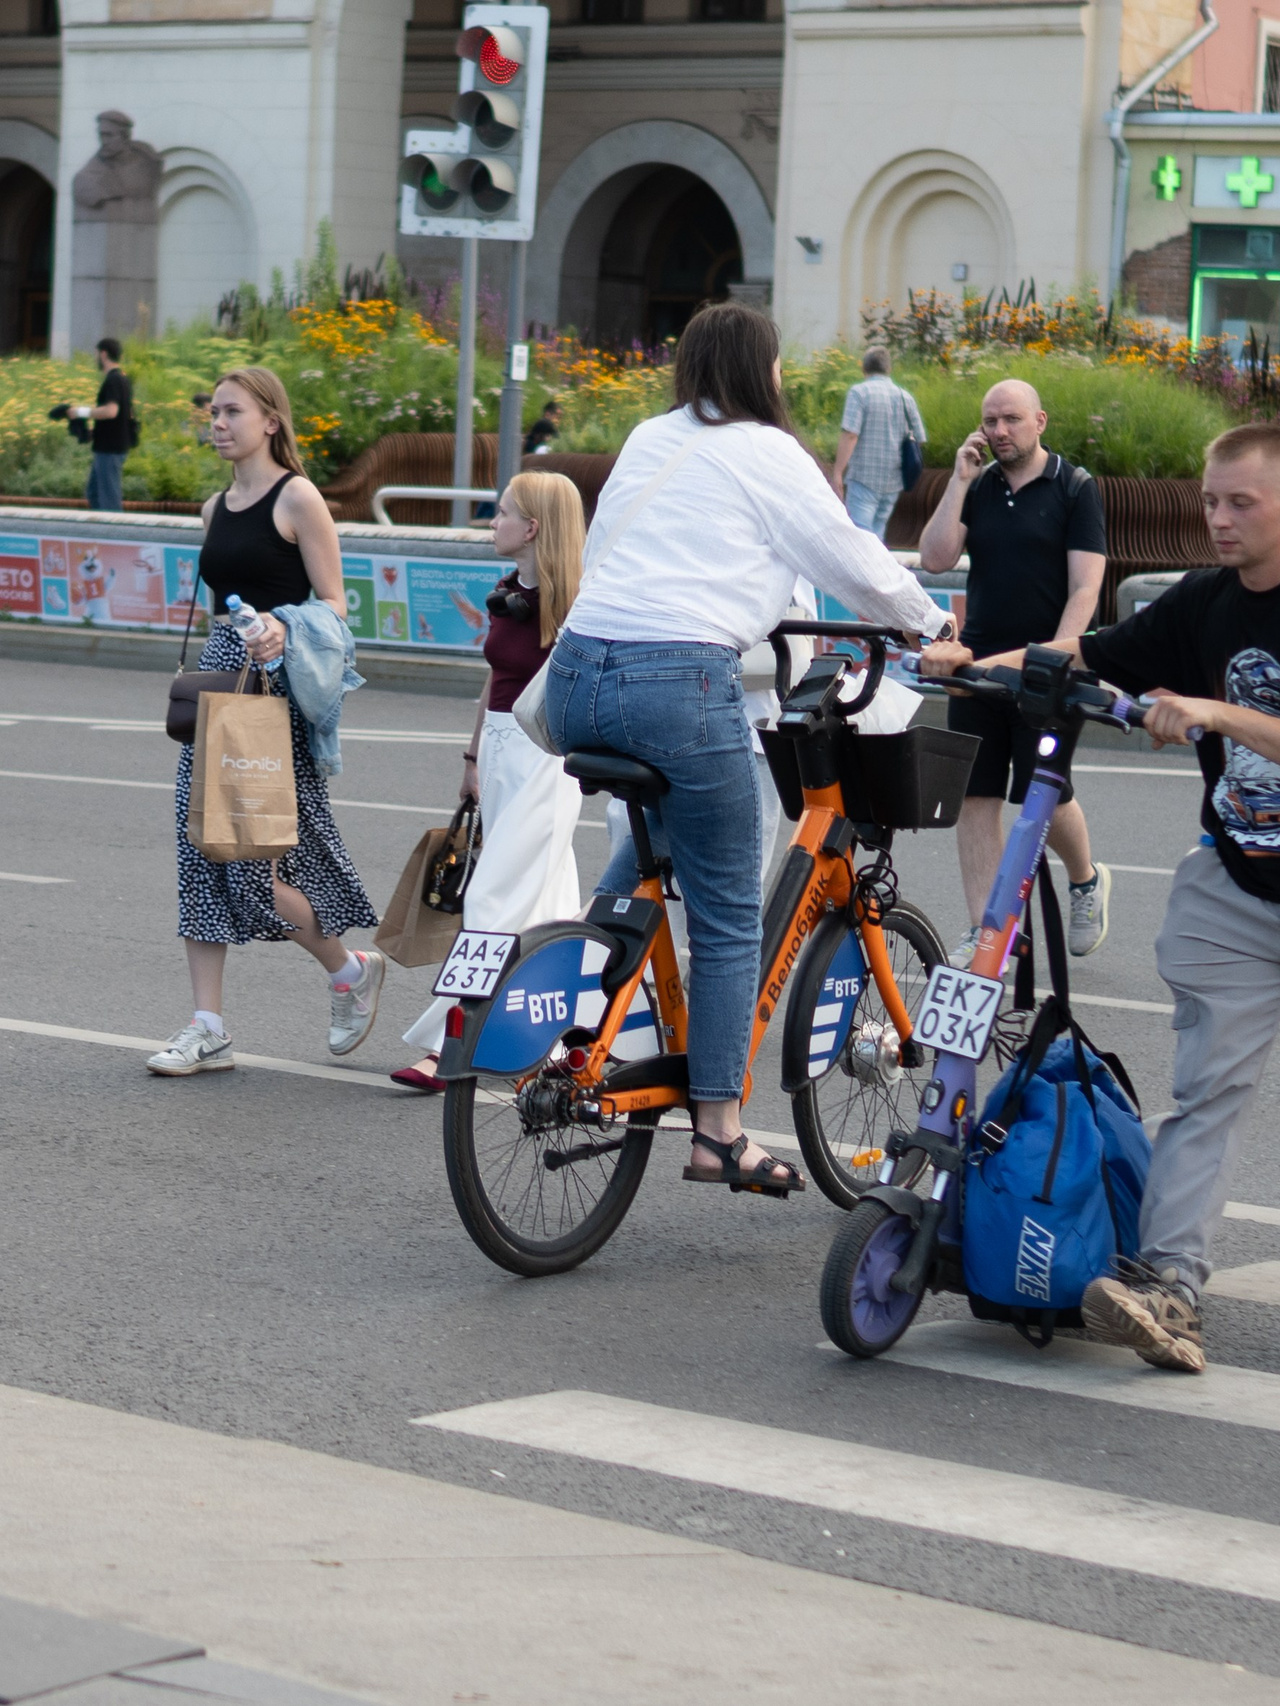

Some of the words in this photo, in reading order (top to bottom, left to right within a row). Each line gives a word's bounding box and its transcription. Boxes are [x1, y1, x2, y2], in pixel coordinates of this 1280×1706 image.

[767, 872, 829, 1001] Велобайк
[528, 991, 568, 1024] ВТБ
[834, 978, 859, 998] ВТБ
[1015, 1215, 1055, 1302] NIKE
